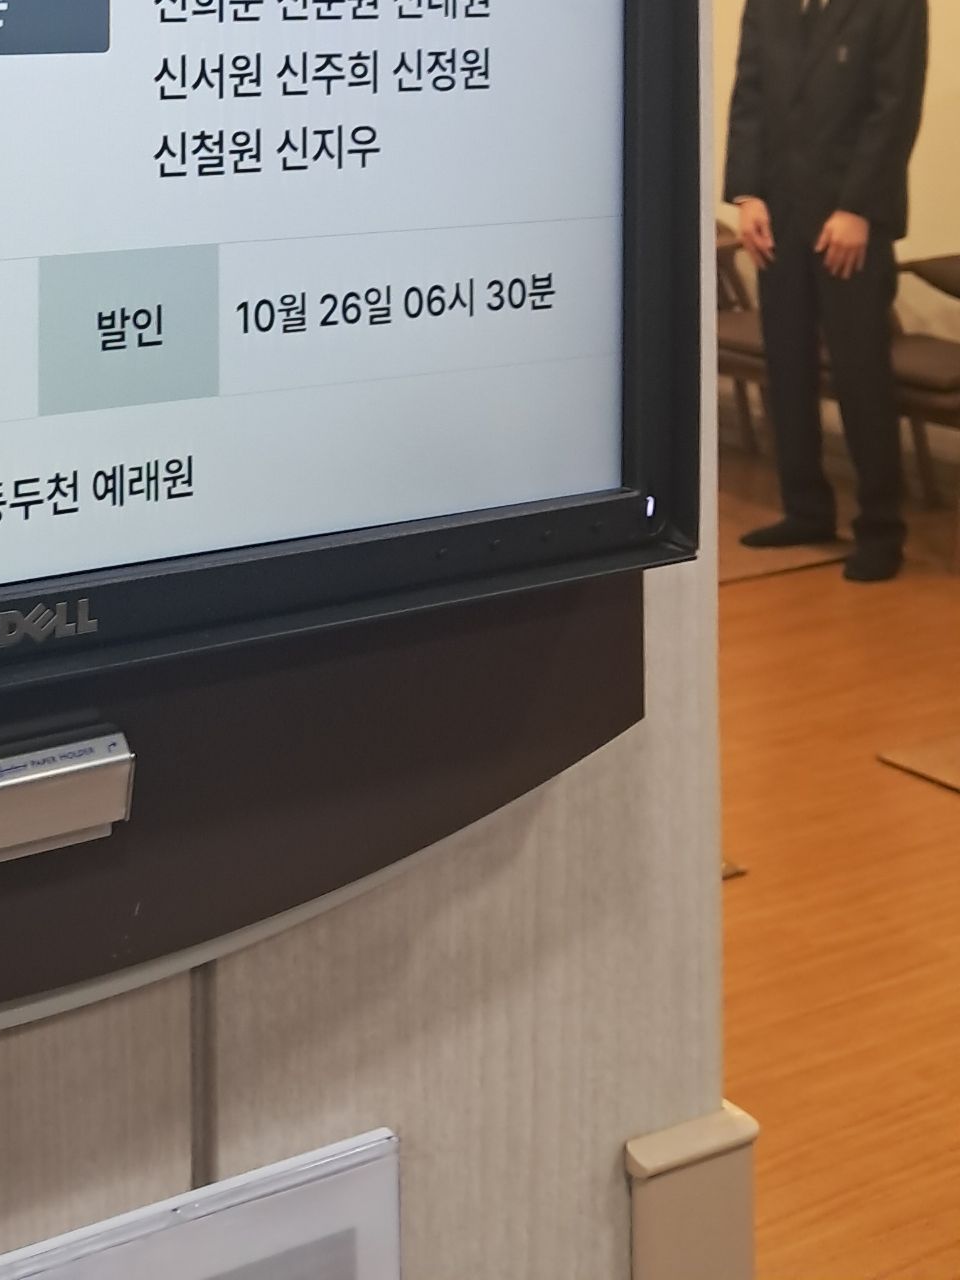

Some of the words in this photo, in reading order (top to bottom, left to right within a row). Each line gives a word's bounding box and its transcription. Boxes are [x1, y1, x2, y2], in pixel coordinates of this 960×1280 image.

[153, 52, 262, 101] 신서원
[276, 49, 378, 97] 신주희
[392, 47, 490, 93] 신정원
[153, 128, 262, 178] 신철원
[276, 124, 381, 172] 신지우
[97, 304, 163, 352] 발인
[236, 291, 307, 334] 10월
[319, 284, 392, 327] 26일
[403, 278, 474, 319] 06시
[486, 272, 556, 312] 30분
[92, 455, 194, 507] 예래원
